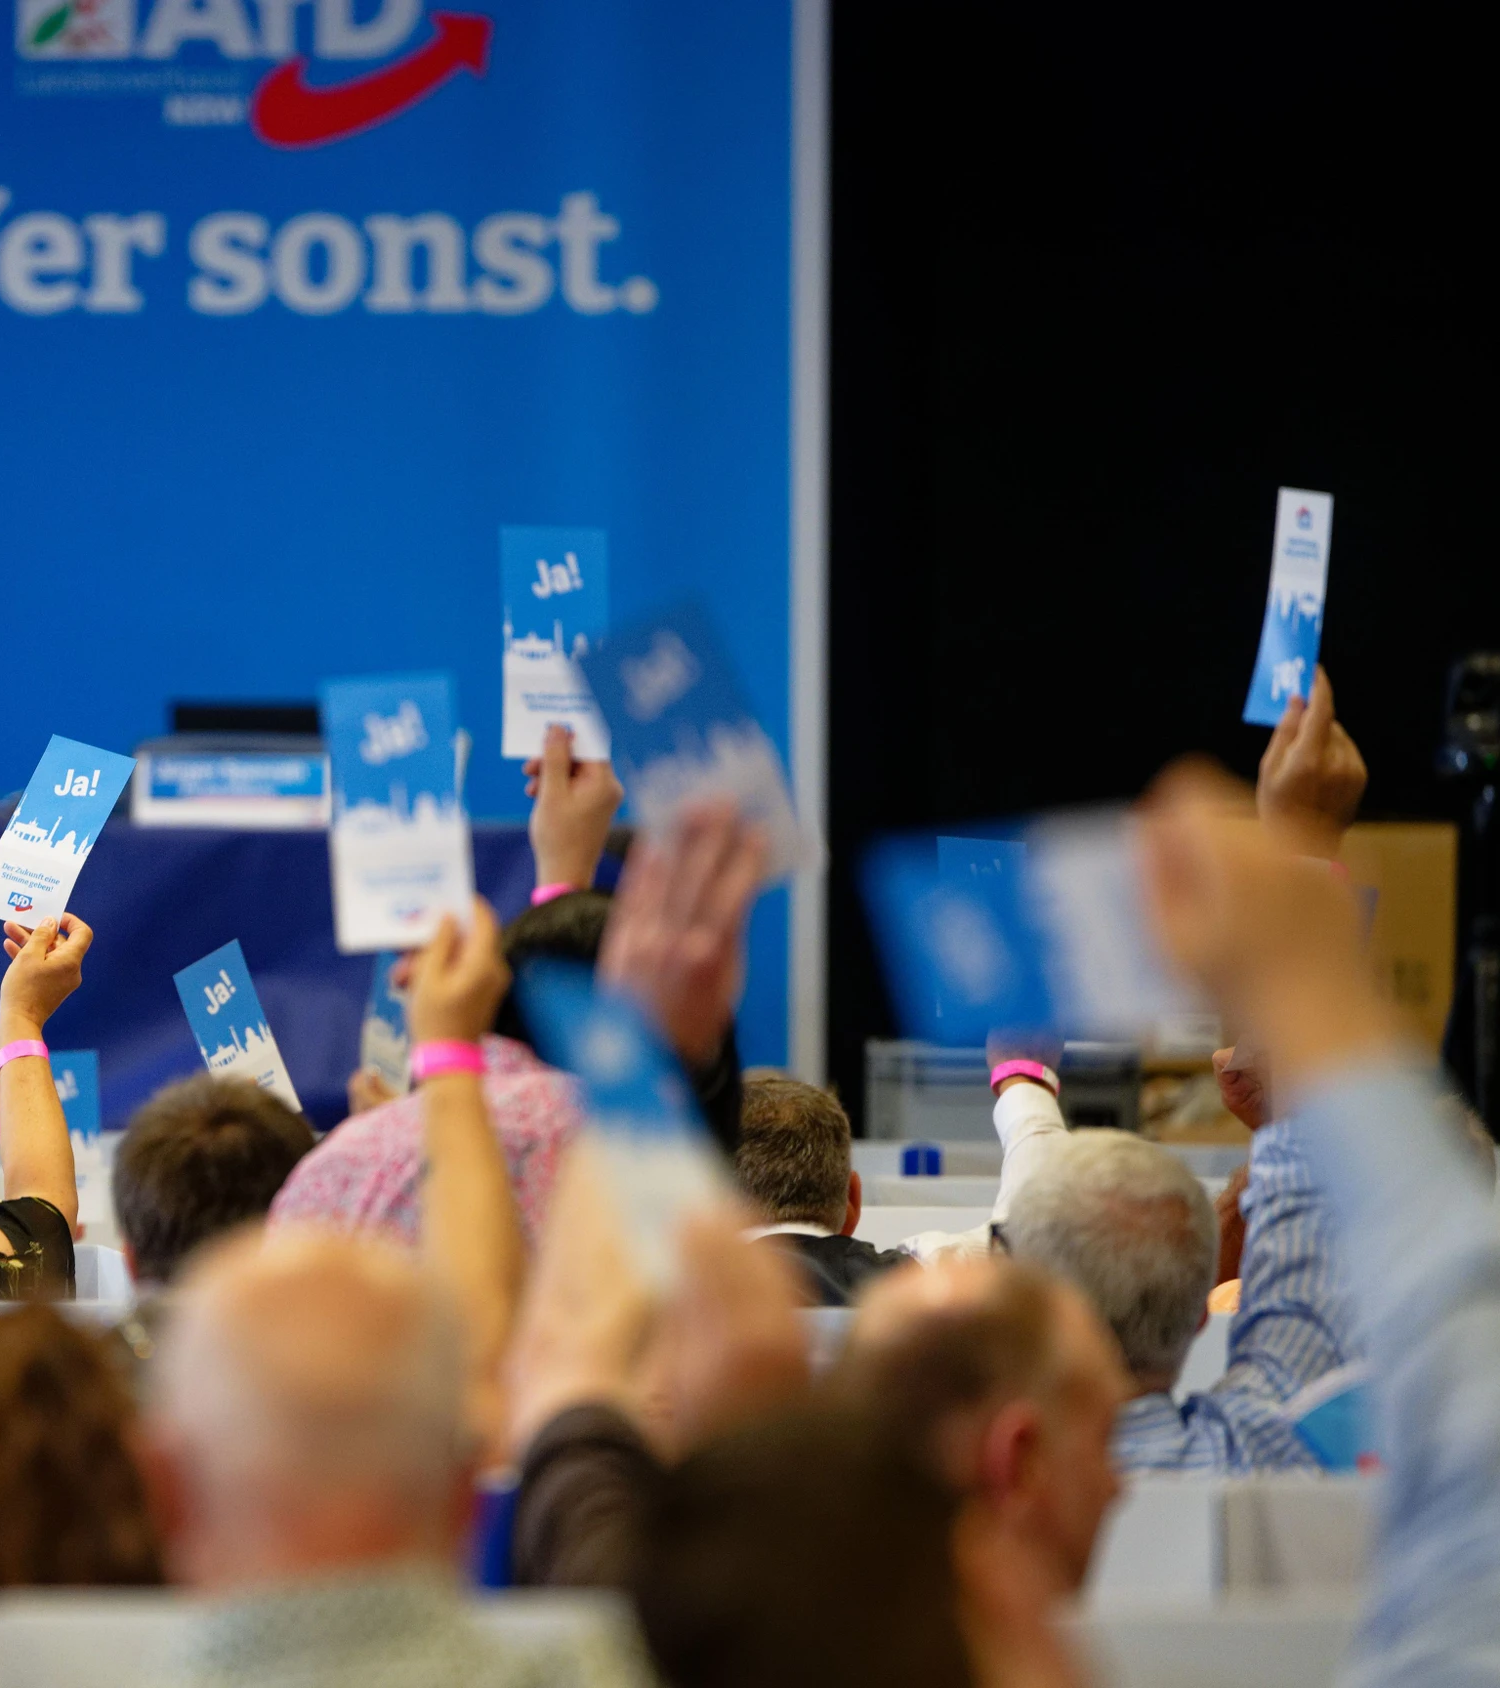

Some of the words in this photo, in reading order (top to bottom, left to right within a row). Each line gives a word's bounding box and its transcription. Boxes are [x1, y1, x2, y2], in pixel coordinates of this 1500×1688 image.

[188, 191, 659, 315] sonst.
[530, 551, 584, 600] Ja!
[53, 768, 101, 797] Ja!
[1, 862, 14, 872] Der
[15, 866, 44, 881] Zukunft
[44, 876, 60, 886] eine
[1, 871, 29, 885] Stimme
[28, 881, 54, 893] geben!
[8, 893, 31, 908] AfD
[204, 968, 237, 1015] Ja!
